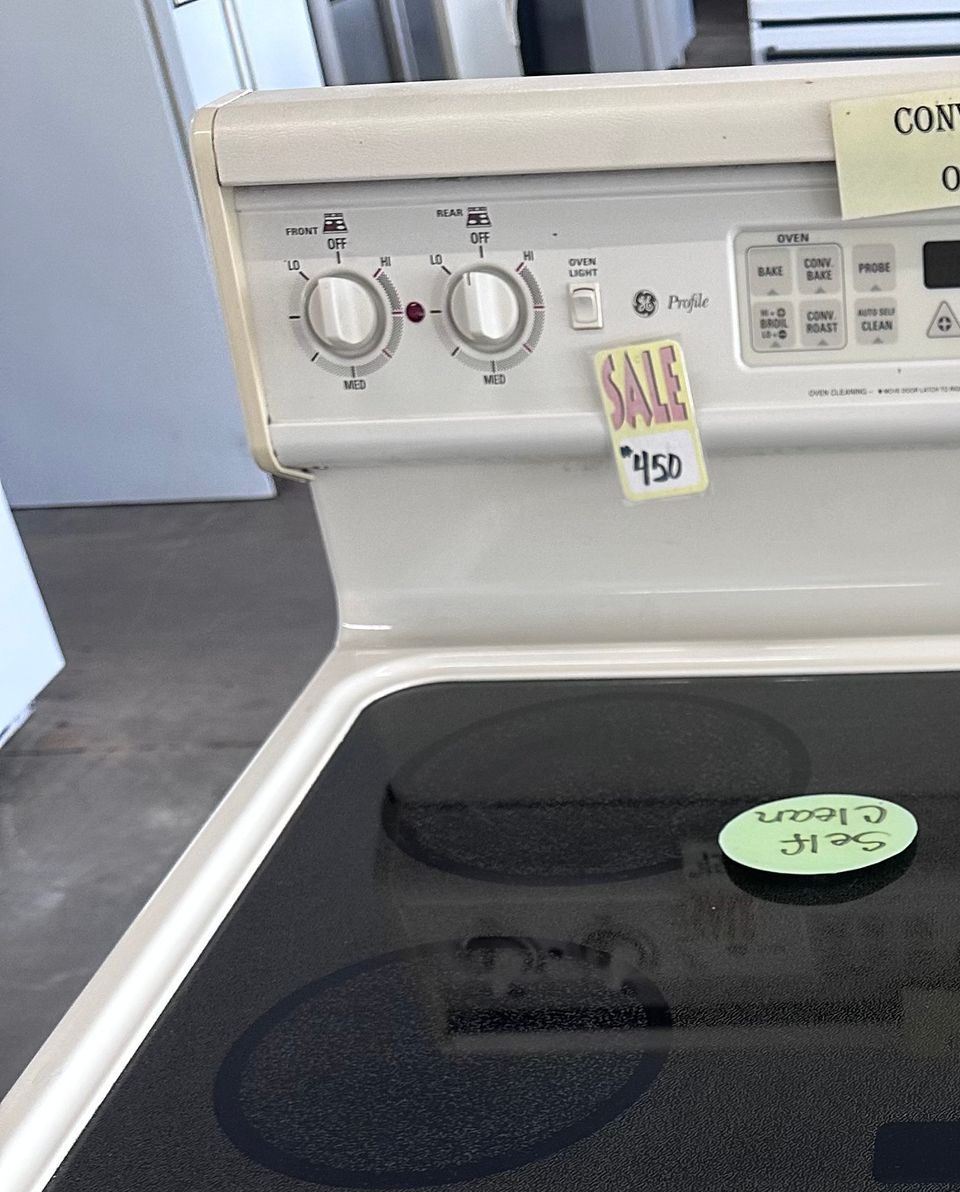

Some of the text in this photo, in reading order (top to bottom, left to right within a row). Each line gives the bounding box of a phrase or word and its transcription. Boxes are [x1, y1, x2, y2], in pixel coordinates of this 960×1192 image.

[436, 208, 463, 218] REAR
[285, 227, 318, 236] FRONT
[327, 238, 348, 249] OFF
[470, 232, 490, 245] OFF
[777, 233, 810, 243] OVEN
[430, 254, 443, 265] LO
[523, 250, 534, 262] HI
[287, 260, 300, 271] LO
[380, 256, 391, 268] HI
[568, 257, 597, 267] OVEN
[858, 262, 891, 273] PROBE
[568, 268, 598, 278] LIGHT
[757, 266, 784, 277] BAKE
[806, 270, 833, 281] BAKE
[667, 295, 709, 313] Profile
[760, 319, 788, 329] BROIL
[806, 323, 838, 333] ROAST
[861, 321, 893, 332] CLEAN
[344, 378, 367, 390] MED
[483, 374, 506, 385] MED
[601, 345, 689, 431] SALE
[755, 805, 888, 826] Clean
[780, 831, 892, 856] Self
